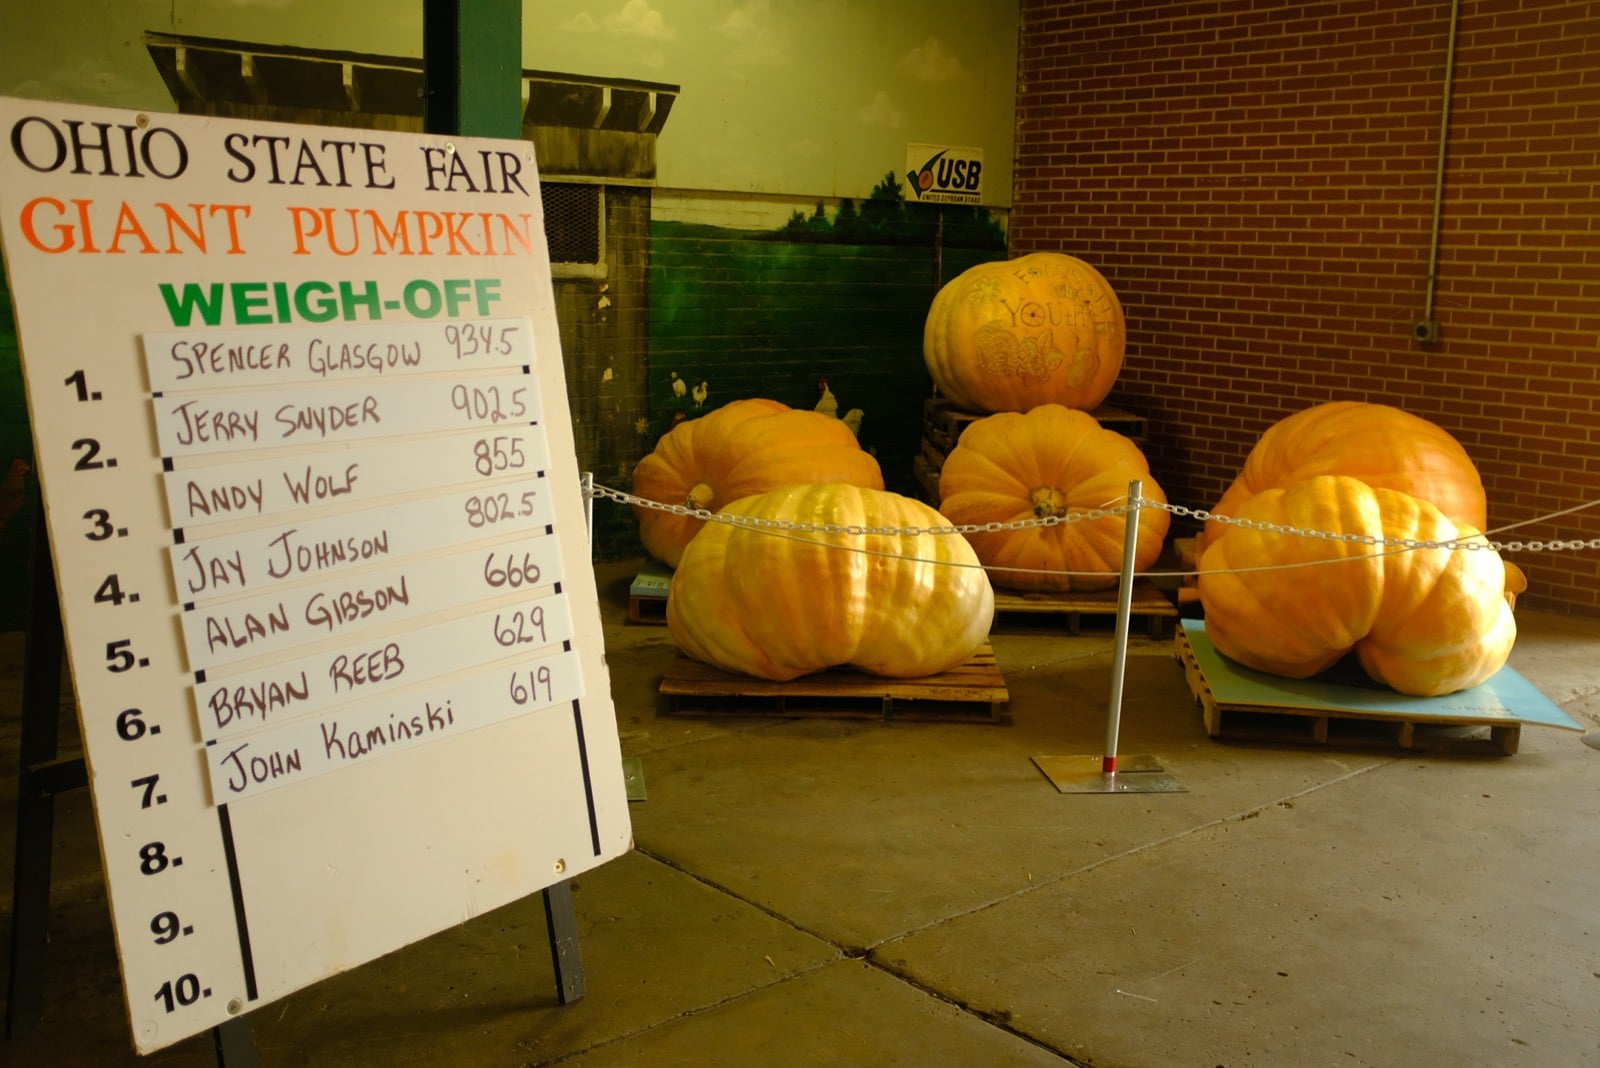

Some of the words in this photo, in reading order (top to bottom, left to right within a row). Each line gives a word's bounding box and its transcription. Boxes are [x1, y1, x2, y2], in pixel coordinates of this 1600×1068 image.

[10, 116, 189, 180] OHIO
[223, 132, 396, 190] STATE
[419, 146, 530, 197] FAIR
[937, 158, 982, 190] USB
[19, 196, 252, 255] GIANT
[286, 206, 531, 257] PUMPKIN
[157, 279, 502, 327] WEIGH-OFF
[170, 340, 291, 380] SPENCER
[307, 338, 421, 378] GLASGOW
[444, 322, 519, 360] 934.5
[64, 369, 103, 402] 1.
[171, 405, 258, 446] JERRY
[274, 395, 381, 439] SNYDER
[450, 383, 527, 425] 902.5
[71, 438, 118, 472] 2.
[186, 479, 263, 518] ANDY
[282, 463, 359, 504] WOLF
[473, 436, 525, 477] 855
[82, 508, 129, 542] 3.
[182, 545, 246, 594] JAY
[267, 529, 389, 580] JOHNSON
[464, 491, 537, 529] 802.5
[93, 573, 140, 606] 4.
[206, 602, 290, 654] ALAN
[305, 575, 410, 632] GIBSON
[484, 552, 541, 589] 666
[106, 638, 150, 673] 5.
[207, 671, 309, 729] BRYAN
[328, 642, 405, 693] REEB
[493, 606, 547, 647] 629
[115, 708, 161, 742] 6.
[220, 742, 302, 793] JOHN
[320, 699, 454, 760] Kaminski
[509, 665, 552, 706] 619
[130, 773, 168, 810] 7.
[138, 841, 183, 876] 8.
[150, 911, 194, 945] 9.
[154, 973, 212, 1014] 10.
